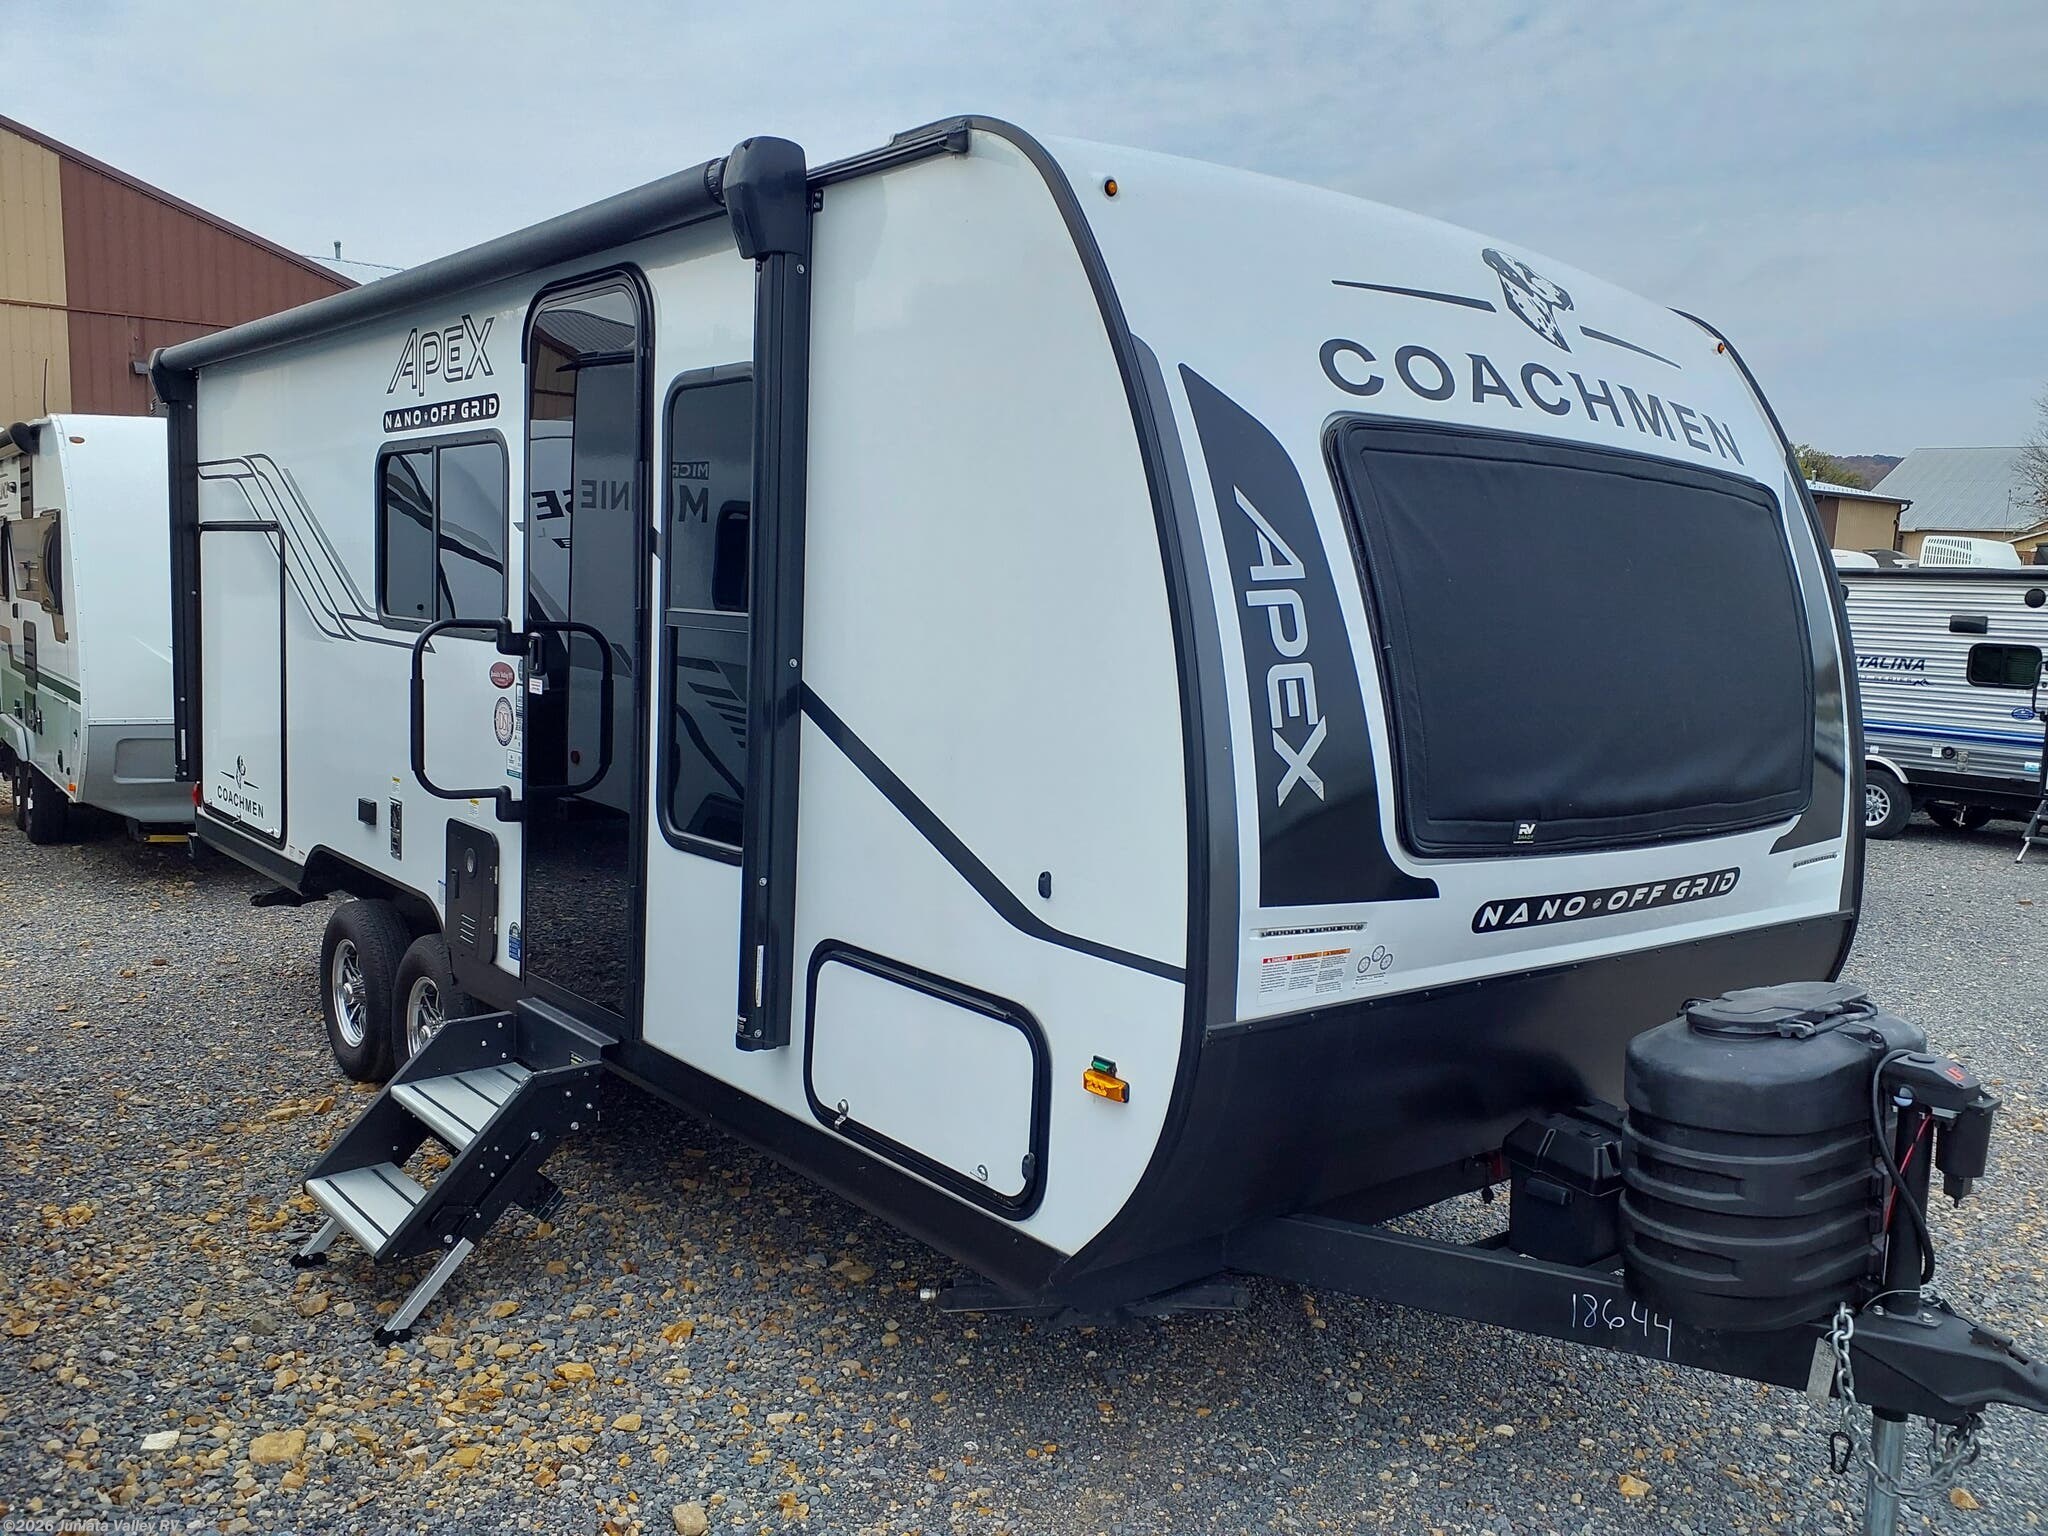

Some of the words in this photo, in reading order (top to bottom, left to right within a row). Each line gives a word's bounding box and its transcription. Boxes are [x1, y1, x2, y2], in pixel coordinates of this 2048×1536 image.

[386, 313, 496, 398] APEX
[385, 410, 422, 430] NANO
[430, 404, 456, 423] OFF
[461, 398, 498, 419] GRID
[1318, 338, 1745, 466] COACHMEN
[1233, 484, 1328, 808] APEX
[1856, 655, 1926, 671] TALINA
[217, 785, 264, 819] COACHMEN
[1519, 823, 1536, 835] RV
[1479, 896, 1587, 928] NANO
[1607, 884, 1667, 911] OFF
[1672, 872, 1736, 900] GRID
[1571, 1293, 1673, 1358] 18644
